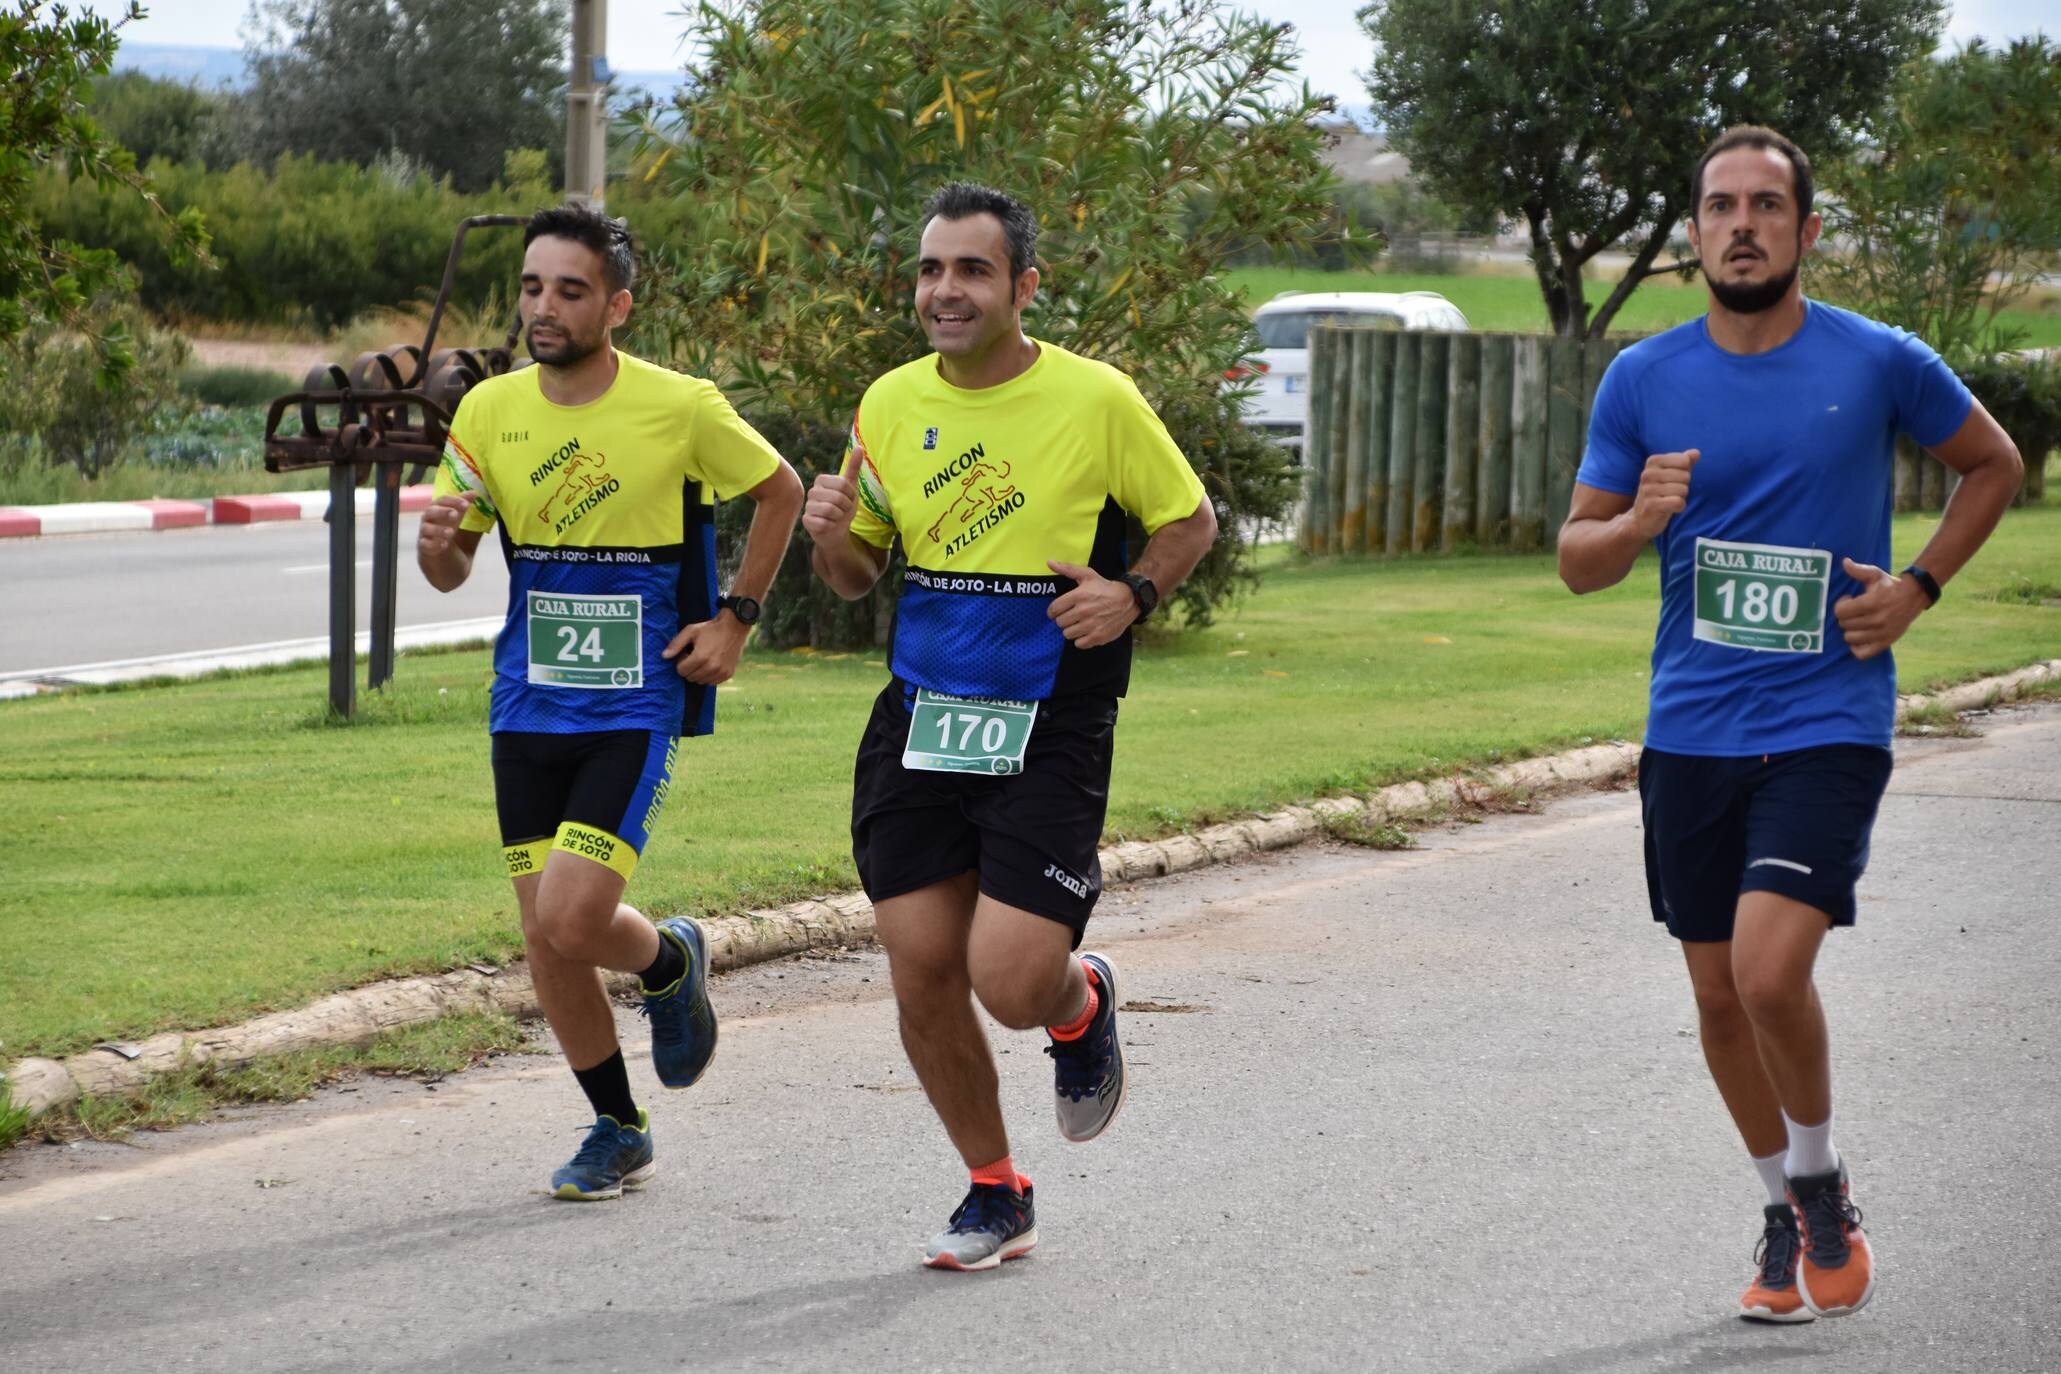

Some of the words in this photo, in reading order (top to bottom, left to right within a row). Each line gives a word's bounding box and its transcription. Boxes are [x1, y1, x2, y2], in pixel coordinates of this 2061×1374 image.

[529, 437, 581, 487] RINCON
[923, 443, 985, 498] RINCON
[555, 478, 621, 536] ATLETISMO
[944, 492, 1026, 560] ATLETISMO
[561, 550, 589, 562] SOTO
[597, 552, 614, 563] LA
[616, 552, 651, 564] RIOJA
[1703, 549, 1748, 569] CAJA
[1752, 554, 1818, 575] RURAL
[932, 577, 948, 589] DE
[949, 579, 985, 592] SOTO
[994, 581, 1013, 594] LA
[1017, 582, 1057, 596] RIOJA
[1715, 579, 1799, 626] 180
[535, 599, 569, 615] CAJA
[572, 601, 632, 617] RURAL
[556, 625, 605, 663] 24
[936, 711, 1007, 753] 170
[562, 838, 577, 849] DE
[578, 843, 610, 861] SOTO
[567, 828, 615, 852] RINCÓN
[510, 860, 533, 872] OTO
[1043, 864, 1088, 899] Joma
